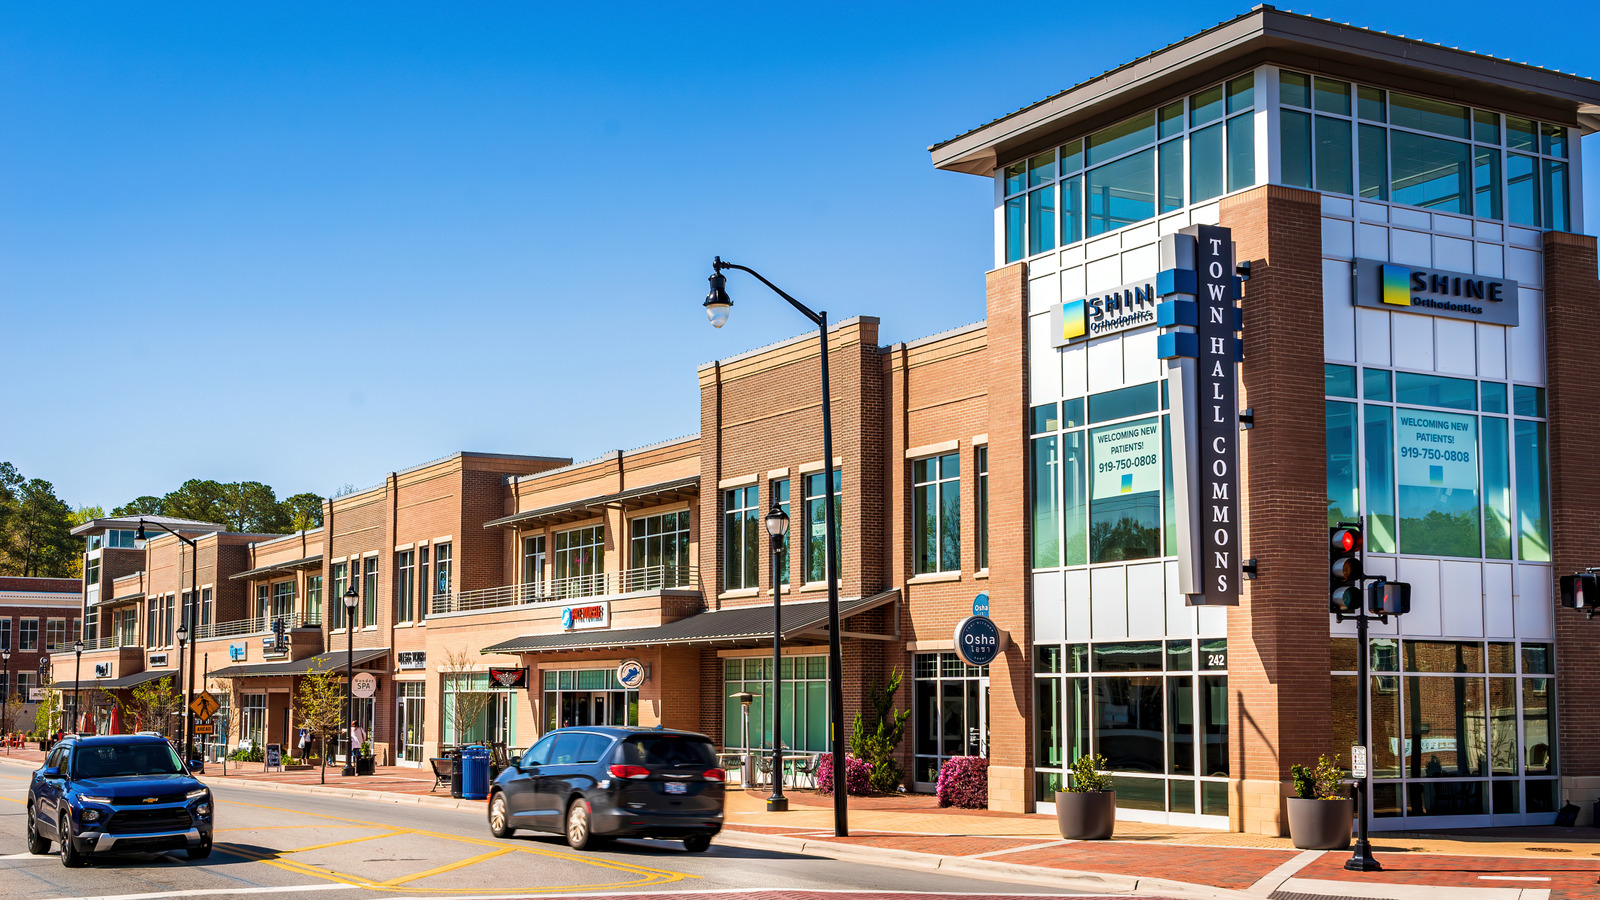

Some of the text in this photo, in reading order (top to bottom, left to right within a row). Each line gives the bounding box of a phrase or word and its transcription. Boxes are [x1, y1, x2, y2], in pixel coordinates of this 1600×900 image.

[1412, 271, 1504, 302] SHINE
[1088, 283, 1151, 317] SHIN
[1413, 296, 1483, 315] Orthodontics
[1090, 310, 1152, 332] Orthodontics
[1206, 238, 1230, 593] TOWN HALL COMMONS
[1400, 416, 1469, 432] WELCOMING NEW
[1097, 425, 1158, 444] WELCOMING NEW
[1416, 432, 1455, 444] PATIENTS!
[1110, 441, 1144, 455] PATIENTS!
[1400, 446, 1470, 463] 919-750-0808
[1098, 453, 1157, 473] 919-750-0808
[974, 604, 989, 612] Osha
[964, 633, 996, 645] Osha
[1208, 654, 1225, 666] 242
[357, 682, 371, 690] SPA
